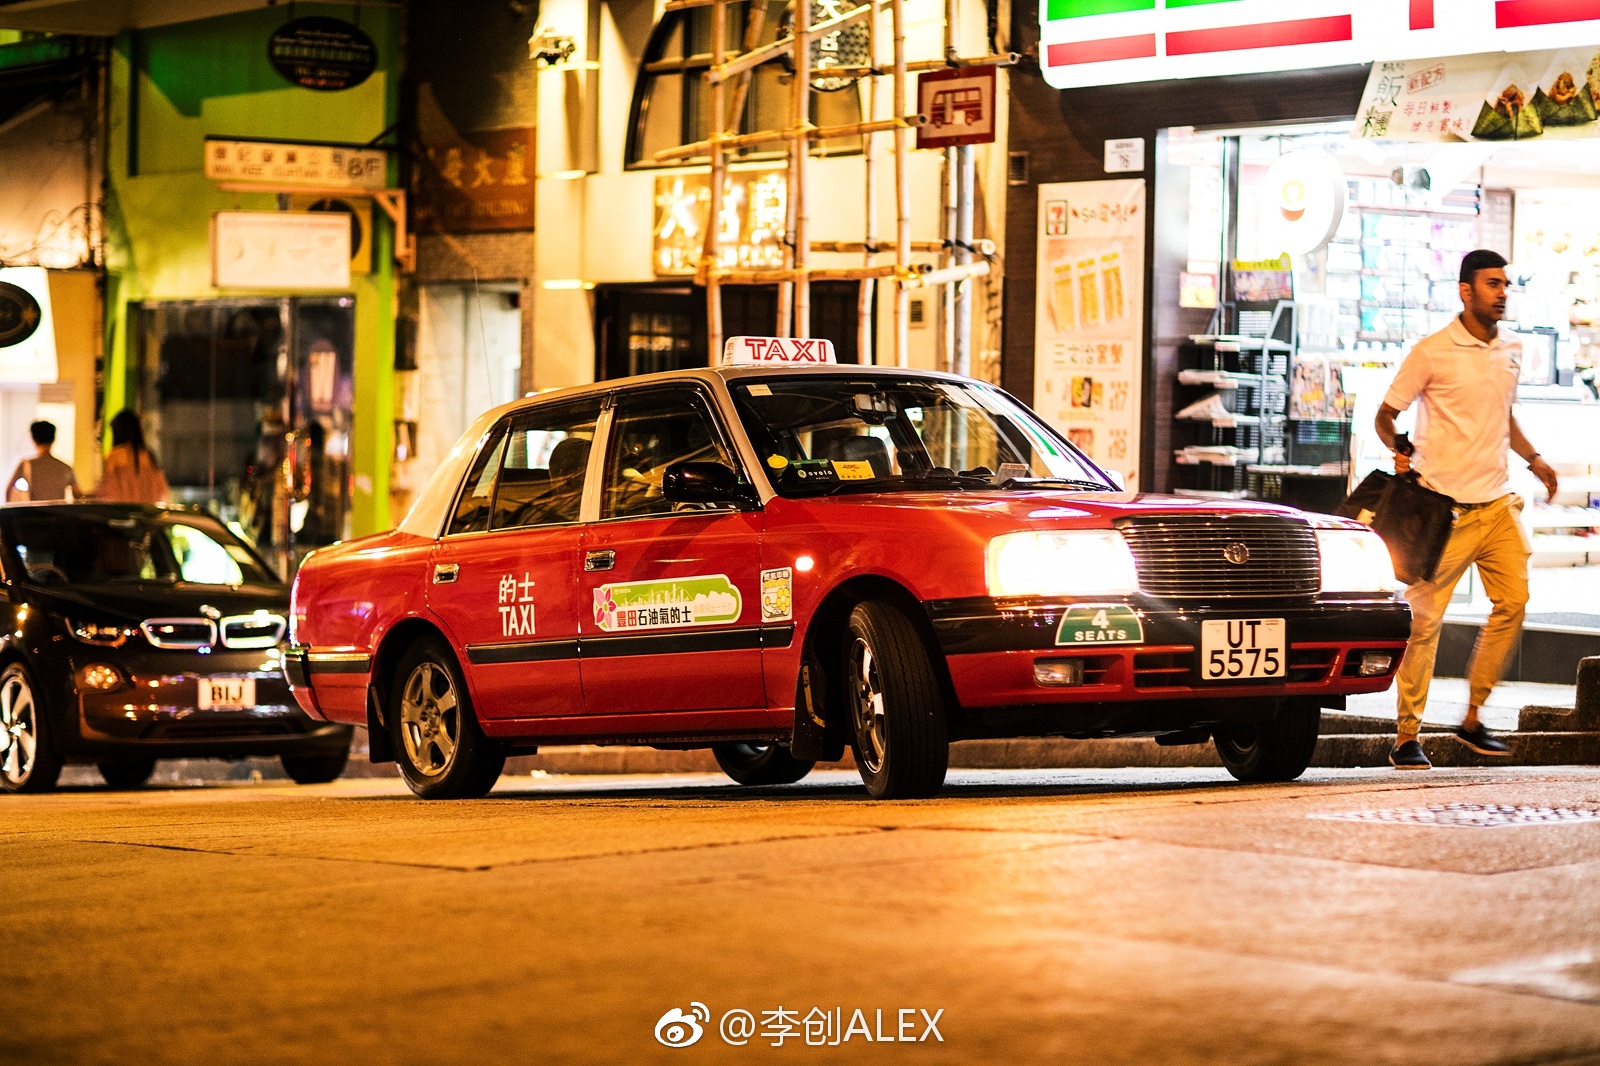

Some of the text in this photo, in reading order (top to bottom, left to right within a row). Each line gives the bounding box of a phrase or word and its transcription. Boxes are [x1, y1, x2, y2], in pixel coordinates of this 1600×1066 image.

[745, 338, 827, 362] TAXI
[499, 571, 536, 604] 的士
[498, 603, 536, 637] TAXI
[616, 605, 692, 628] 豐田石油氣的士
[1091, 609, 1110, 629] 4
[1074, 629, 1127, 641] SEATS
[1227, 620, 1262, 648] UT
[1209, 647, 1280, 678] 5575
[211, 686, 243, 704] BIJ
